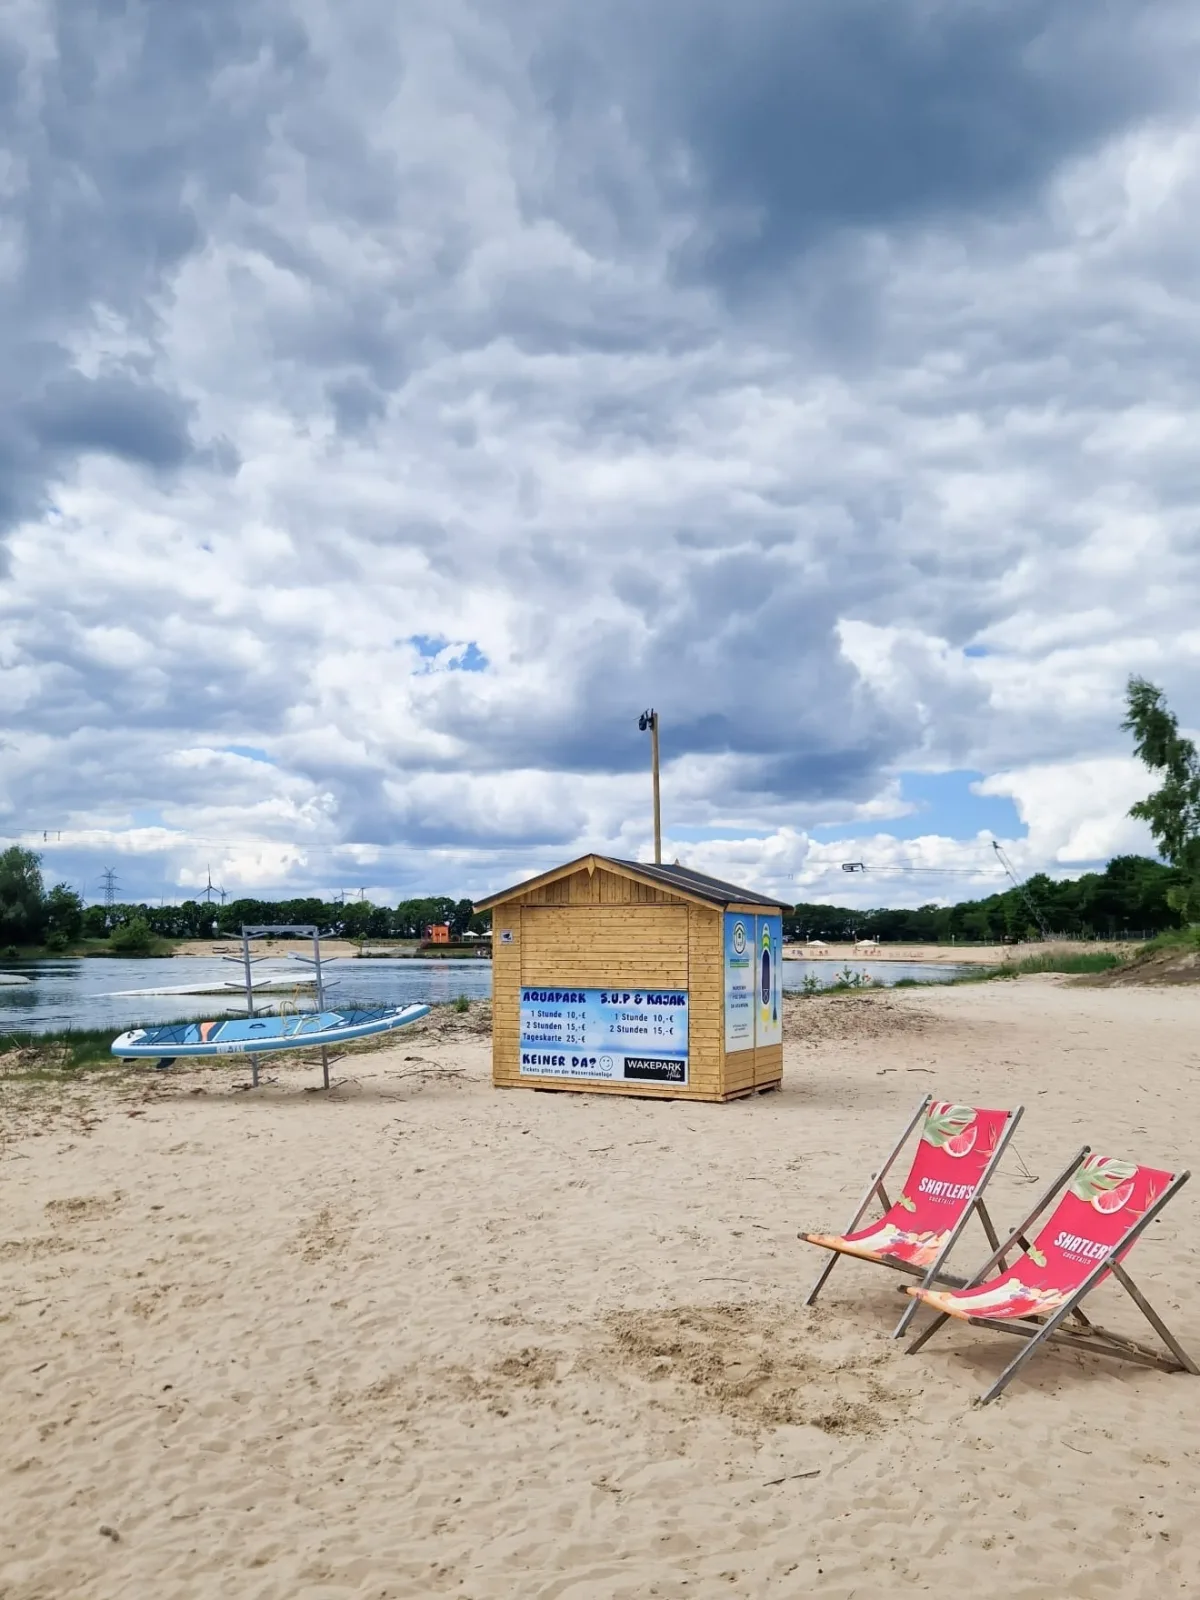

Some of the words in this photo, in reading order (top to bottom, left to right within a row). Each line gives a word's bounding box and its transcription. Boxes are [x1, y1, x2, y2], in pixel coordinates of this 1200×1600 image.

[523, 991, 586, 1003] AQUAPARK
[600, 993, 630, 1004] S.U.P
[634, 994, 643, 1005] &
[647, 993, 686, 1006] KAJAK
[537, 1010, 562, 1018] Stunde
[566, 1011, 586, 1020] 10,-€
[621, 1013, 648, 1021] Stunde
[653, 1014, 674, 1023] 10,-€
[526, 1021, 531, 1029] 2
[533, 1021, 562, 1030] Stunden
[566, 1023, 586, 1032] 15,-€
[609, 1025, 615, 1033] 2
[616, 1025, 648, 1034] Stunden
[653, 1026, 674, 1036] 15,-€
[522, 1032, 562, 1042] Tageskarte
[566, 1034, 586, 1043] 25,-€
[522, 1053, 566, 1067] KEINER
[571, 1056, 597, 1068] DA?
[627, 1059, 682, 1071] WAKEPARK
[918, 1177, 975, 1200] SHATLER'S
[1053, 1231, 1114, 1261] SHATLER'
